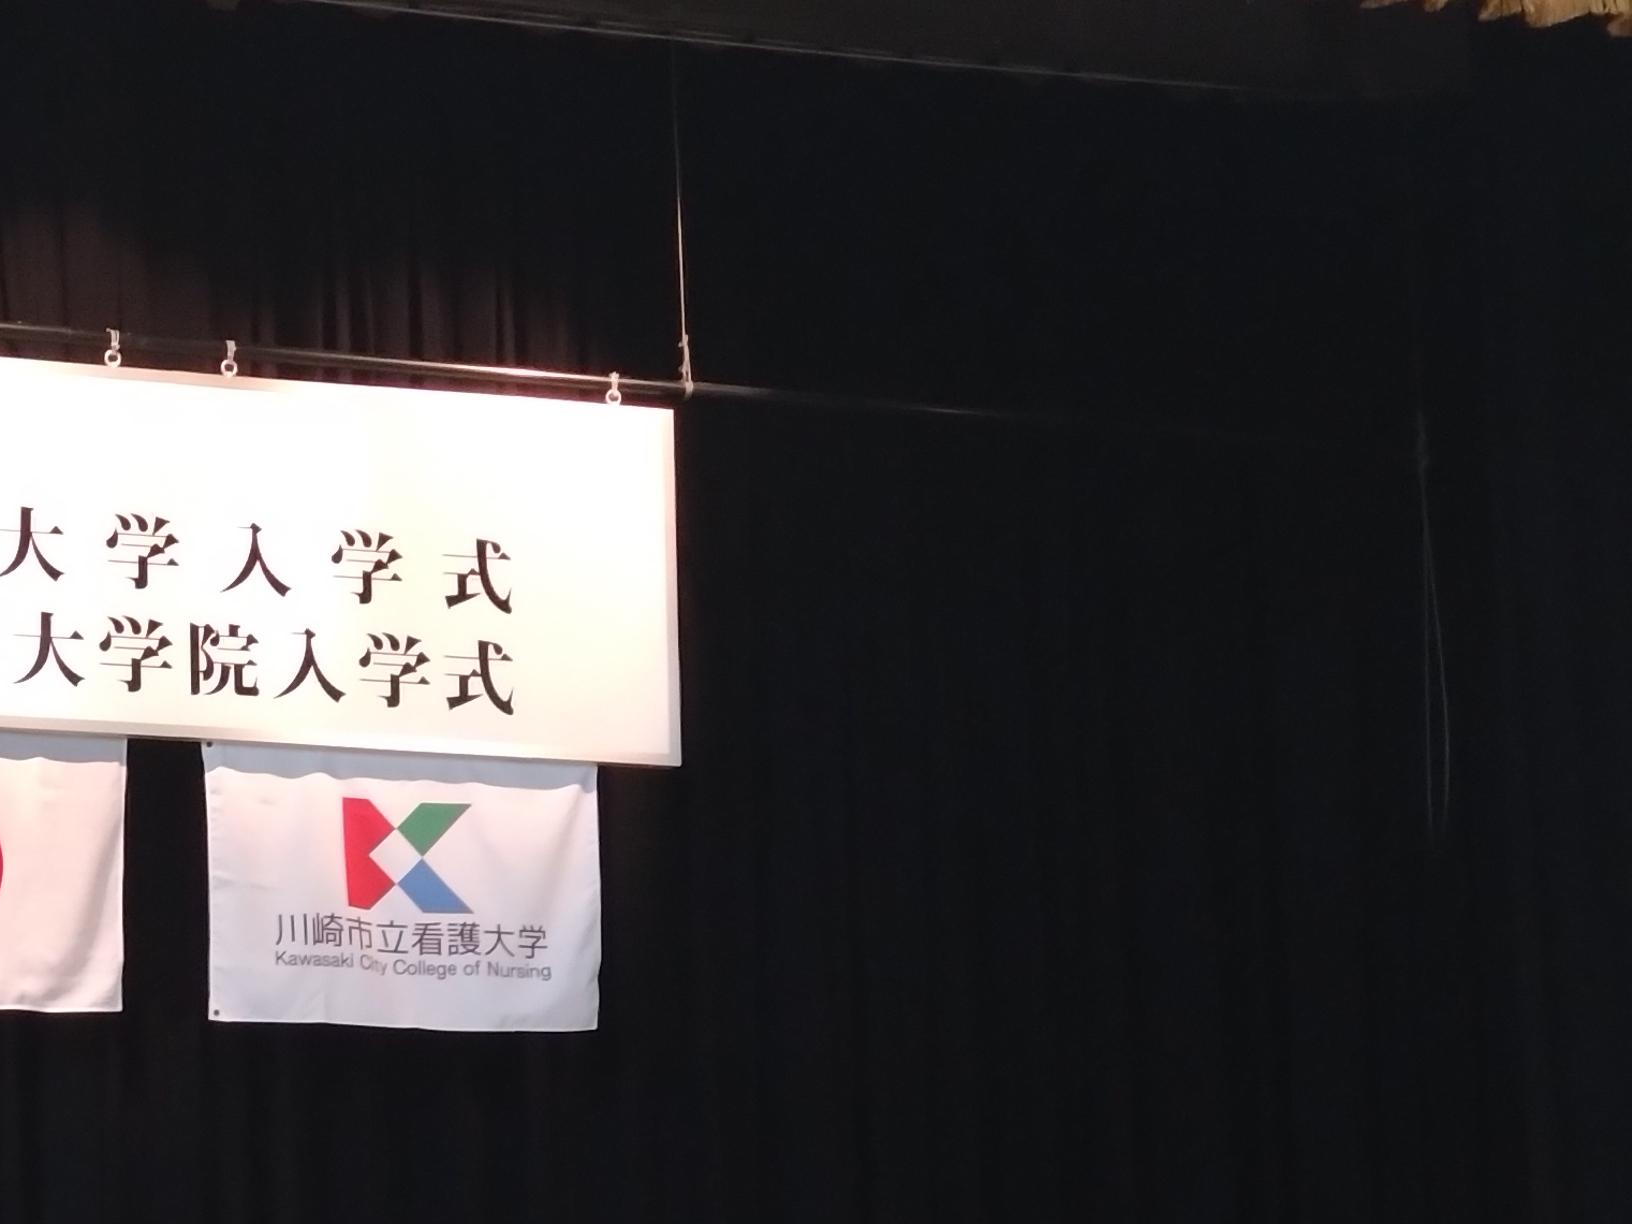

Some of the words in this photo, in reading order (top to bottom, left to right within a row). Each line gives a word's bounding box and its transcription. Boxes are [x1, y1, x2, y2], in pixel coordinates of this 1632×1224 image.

[275, 912, 549, 960] 川崎市立看護大学
[275, 950, 355, 968] Kawasaki
[359, 953, 388, 976] City
[393, 958, 457, 980] College
[463, 960, 481, 976] of
[487, 961, 553, 981] Nursing
